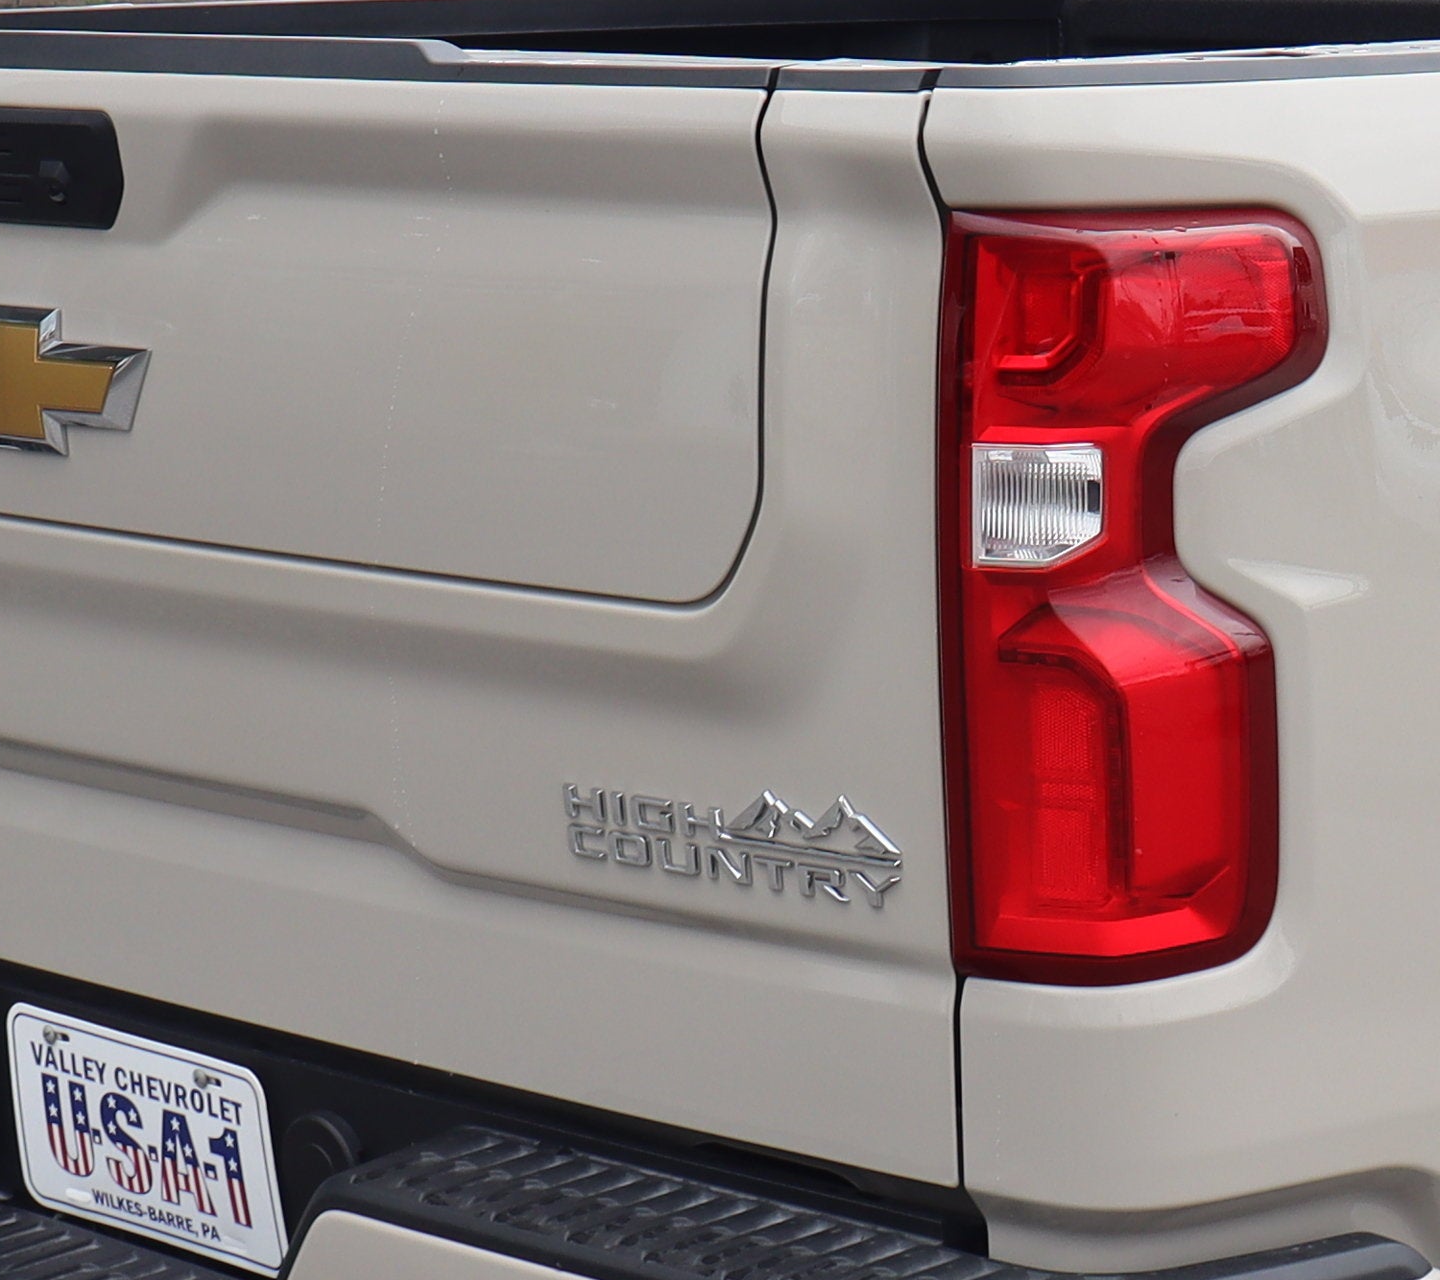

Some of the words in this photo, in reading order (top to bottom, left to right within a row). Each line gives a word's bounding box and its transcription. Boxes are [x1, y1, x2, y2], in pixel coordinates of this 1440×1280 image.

[562, 782, 725, 838] HIGH
[566, 822, 902, 909] COUNTRY
[30, 1040, 107, 1086] VALLEY
[113, 1066, 243, 1126] CHEVROLET
[91, 1188, 199, 1238] WILKES-BARRE,
[202, 1224, 221, 1242] PA
